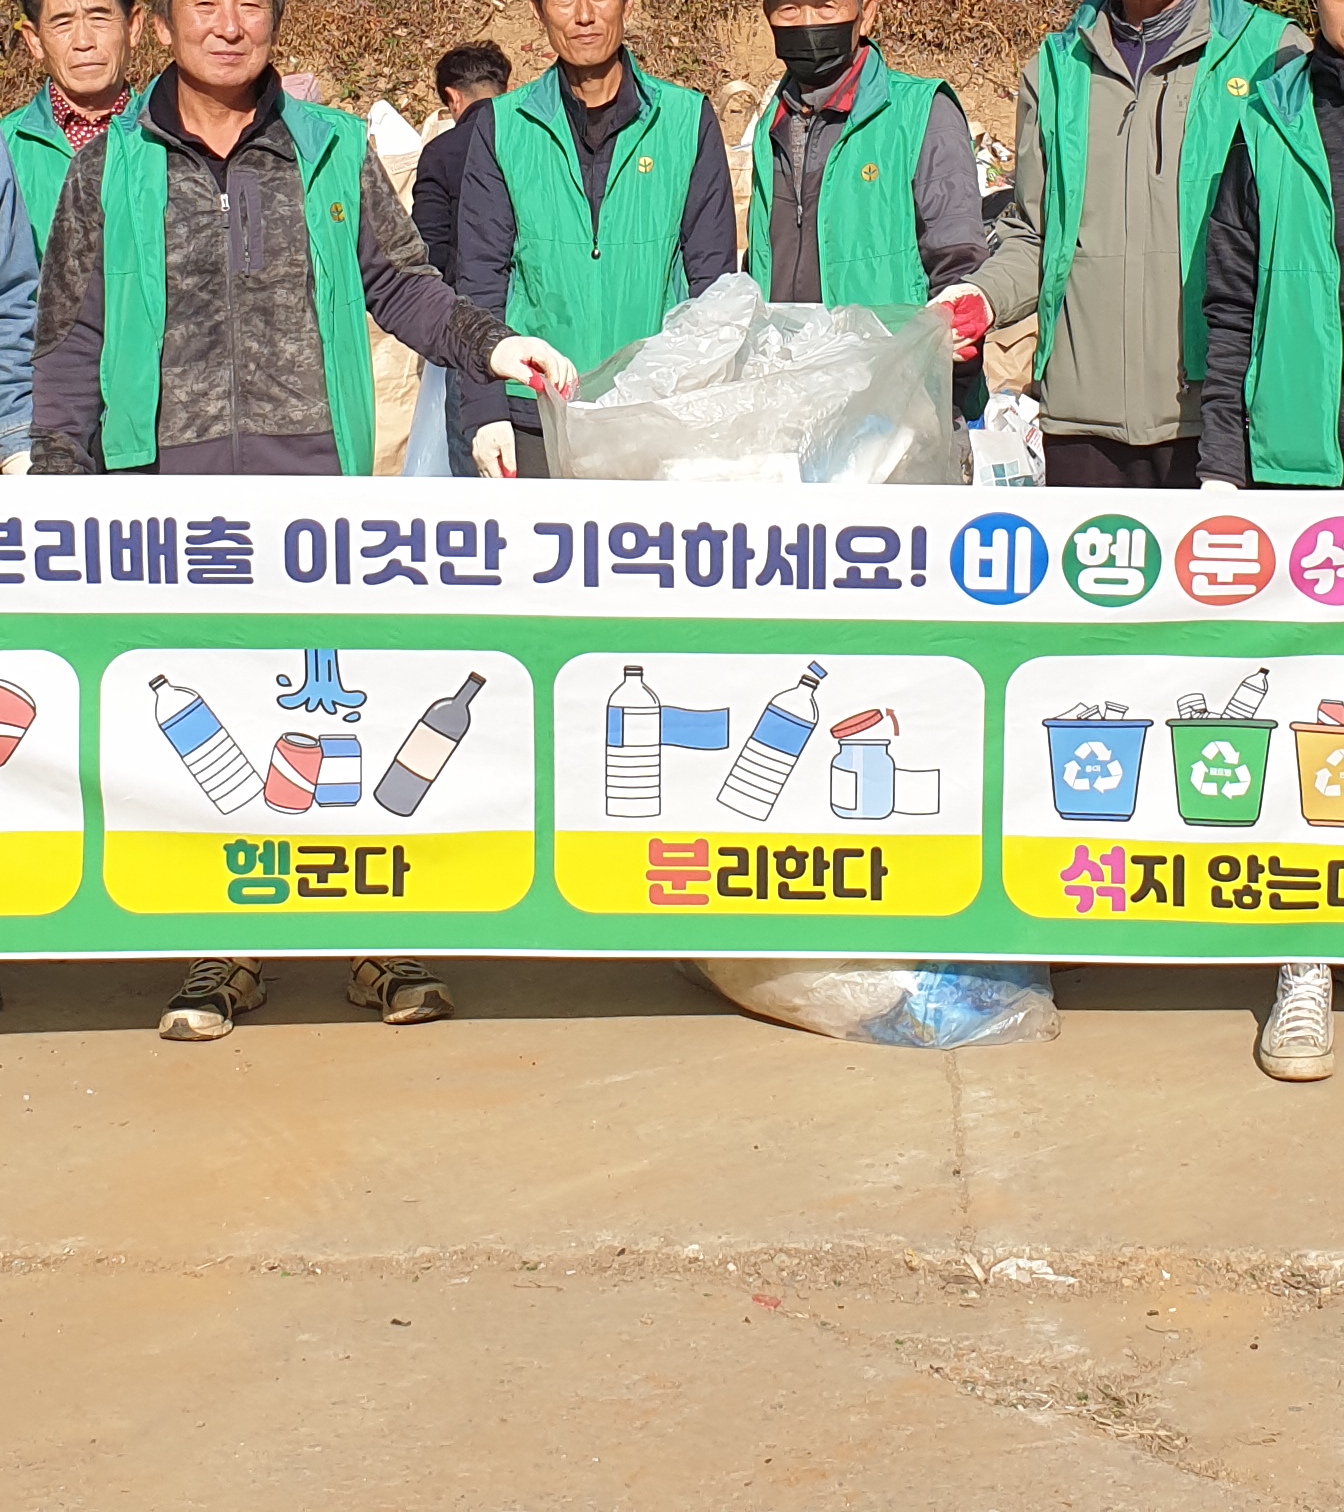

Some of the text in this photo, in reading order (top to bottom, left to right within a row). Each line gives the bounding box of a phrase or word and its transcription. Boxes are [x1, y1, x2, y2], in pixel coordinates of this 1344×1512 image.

[285, 518, 508, 586] 이것만
[533, 520, 927, 590] 기억하세요!
[964, 526, 1032, 595] 비
[1074, 526, 1146, 596] 헹
[1189, 529, 1261, 596] 분
[223, 838, 410, 906] 헹군다
[645, 838, 889, 907] 분리한다
[1060, 844, 1185, 914] 섞지
